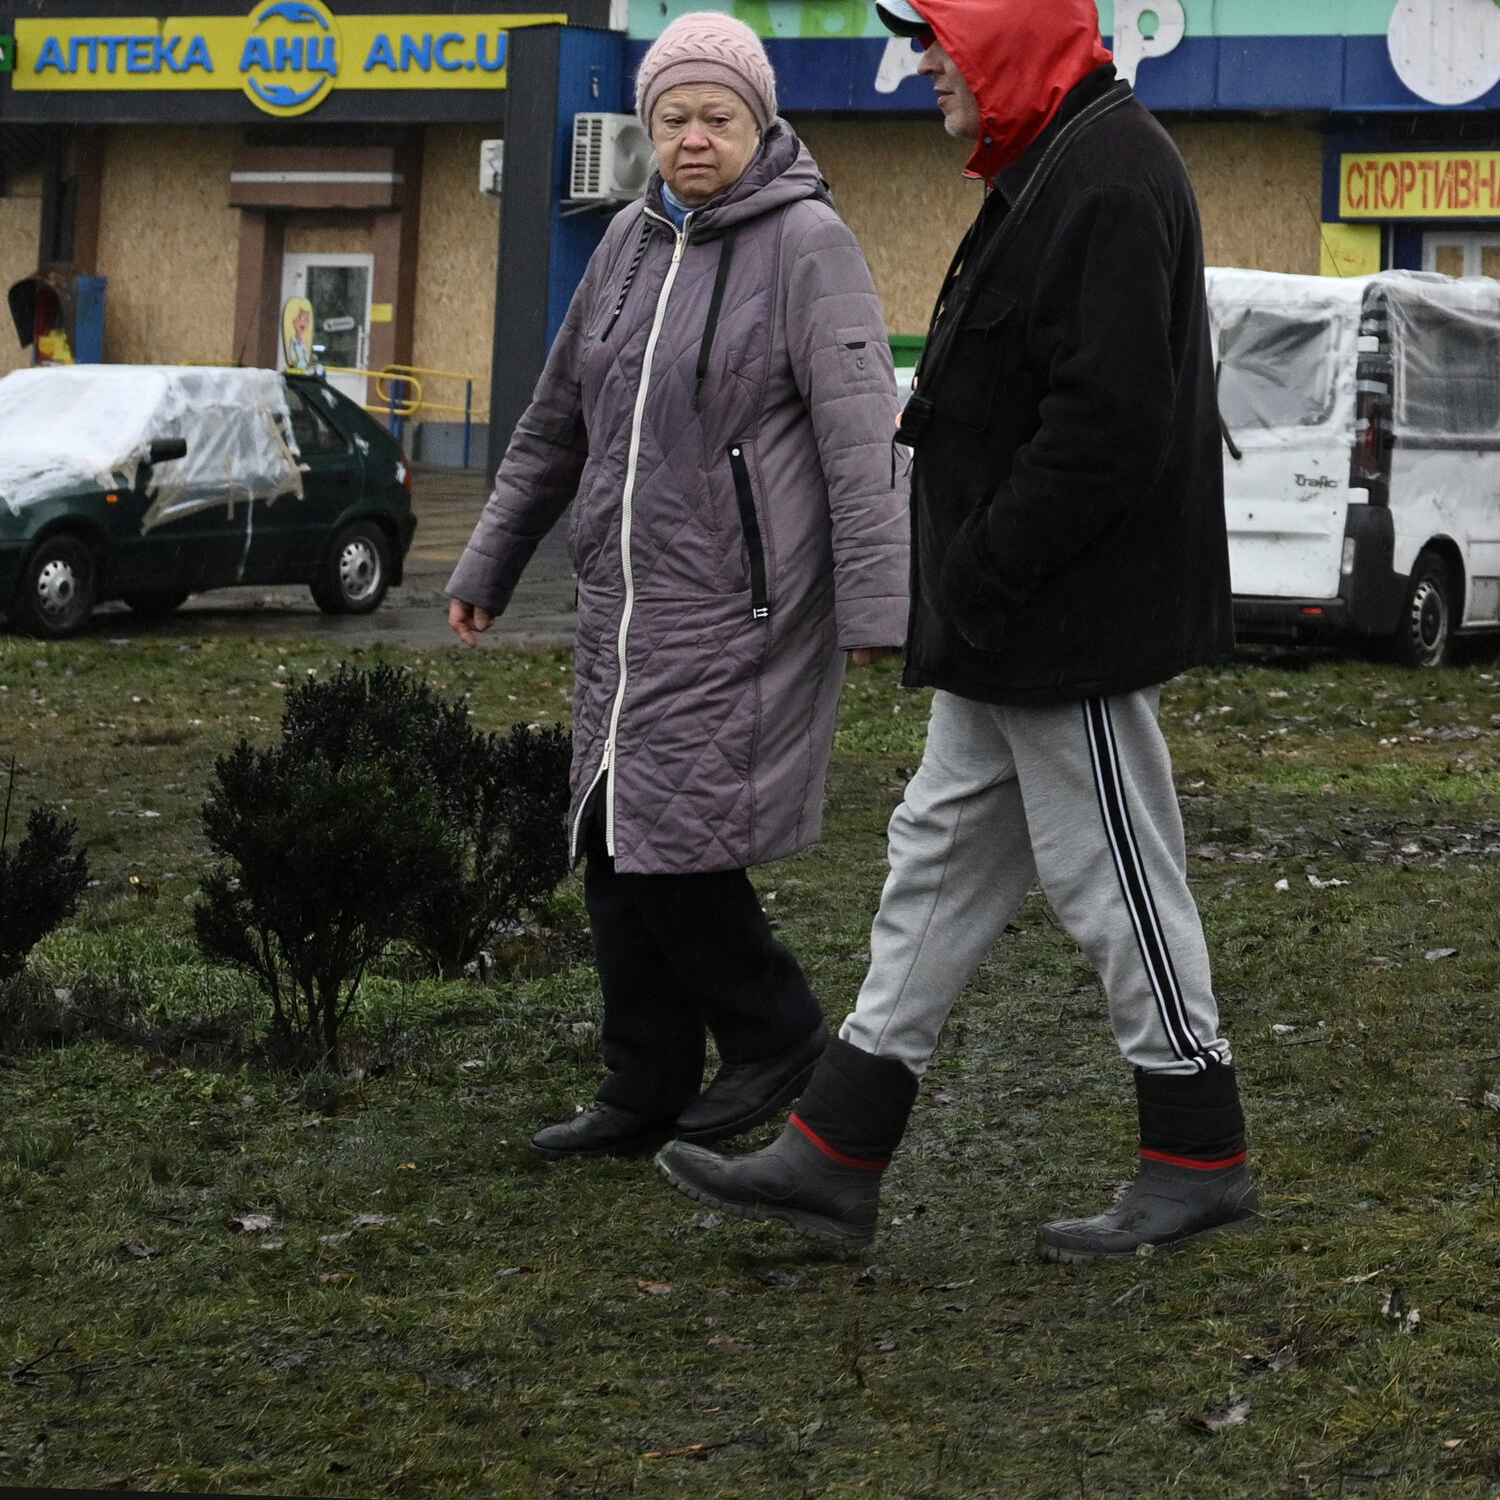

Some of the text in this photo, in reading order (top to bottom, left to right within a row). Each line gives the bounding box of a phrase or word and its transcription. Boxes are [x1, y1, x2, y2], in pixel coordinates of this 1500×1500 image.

[34, 34, 213, 74] АПТЕКА
[239, 36, 338, 77] АНЦ
[1294, 473, 1338, 488] Trafic
